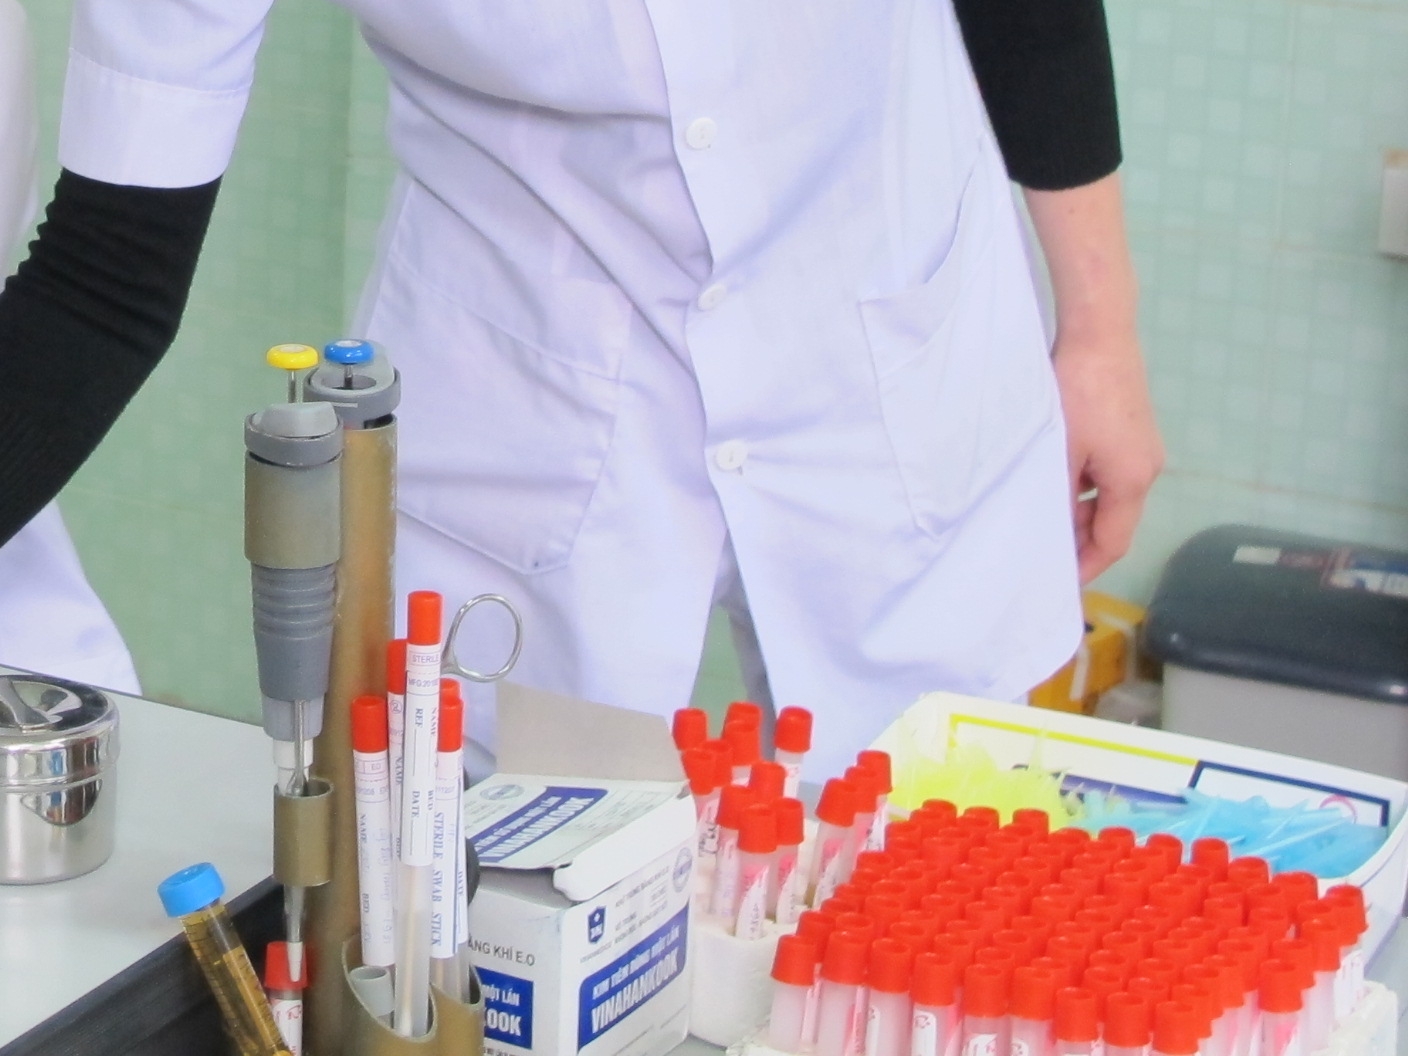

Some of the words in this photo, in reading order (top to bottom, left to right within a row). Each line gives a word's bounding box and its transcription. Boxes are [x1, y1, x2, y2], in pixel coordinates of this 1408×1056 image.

[411, 790, 420, 818] DATE
[359, 813, 368, 844] NAME
[432, 811, 445, 860] STERILE
[432, 869, 443, 903] SWAB
[430, 913, 443, 947] STICK
[492, 944, 514, 961] KHÍ
[592, 946, 679, 1035] VINAHANKOOK
